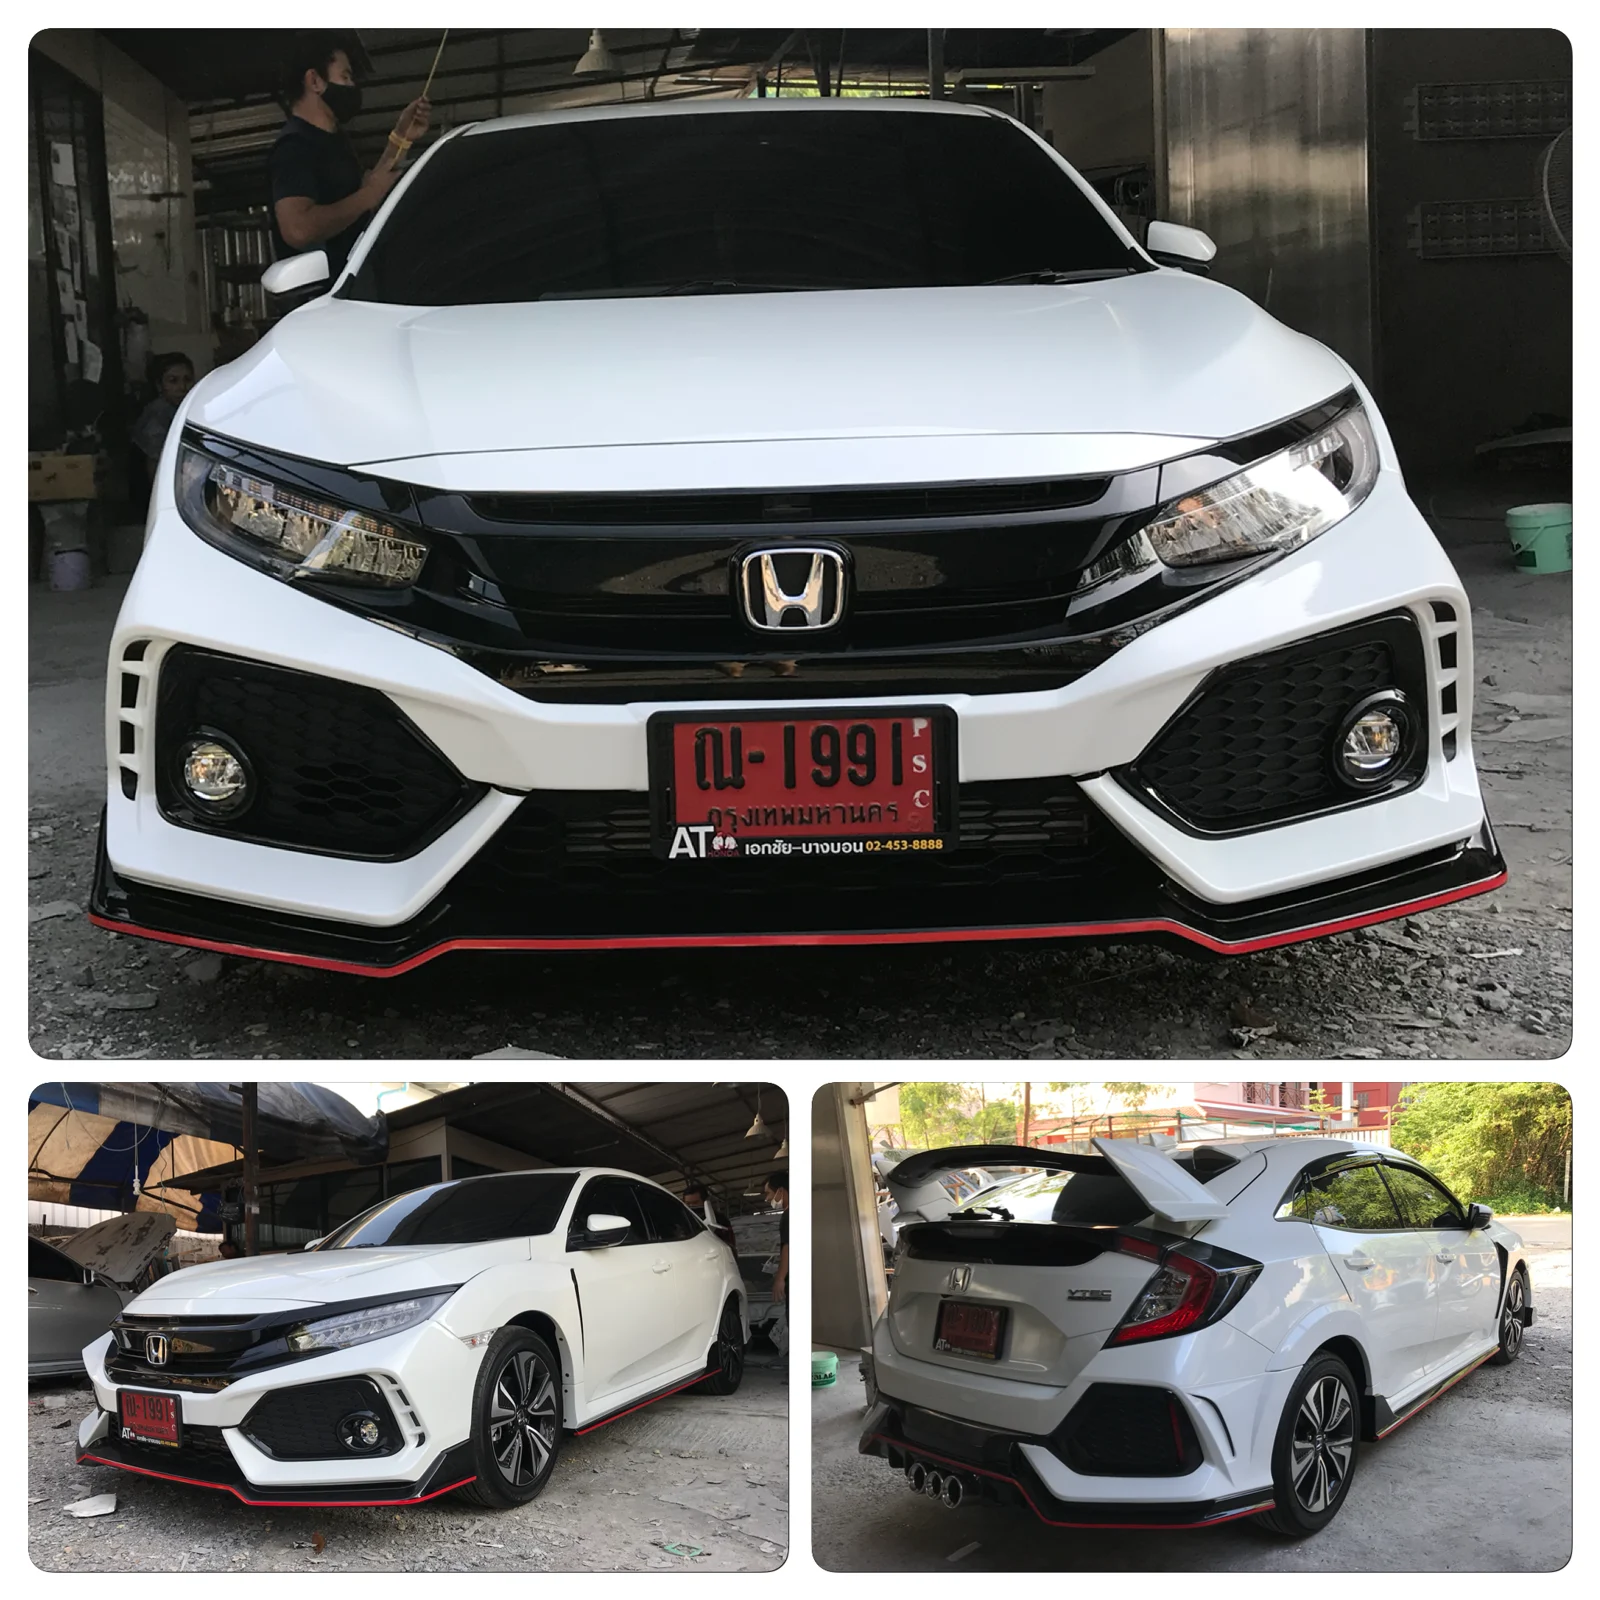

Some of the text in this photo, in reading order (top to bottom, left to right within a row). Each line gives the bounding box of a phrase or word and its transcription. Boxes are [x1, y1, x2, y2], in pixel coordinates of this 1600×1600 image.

[707, 803, 899, 833] กรุงเทพมหานคร
[668, 826, 714, 859] AT
[865, 839, 943, 851] 02-453-8888
